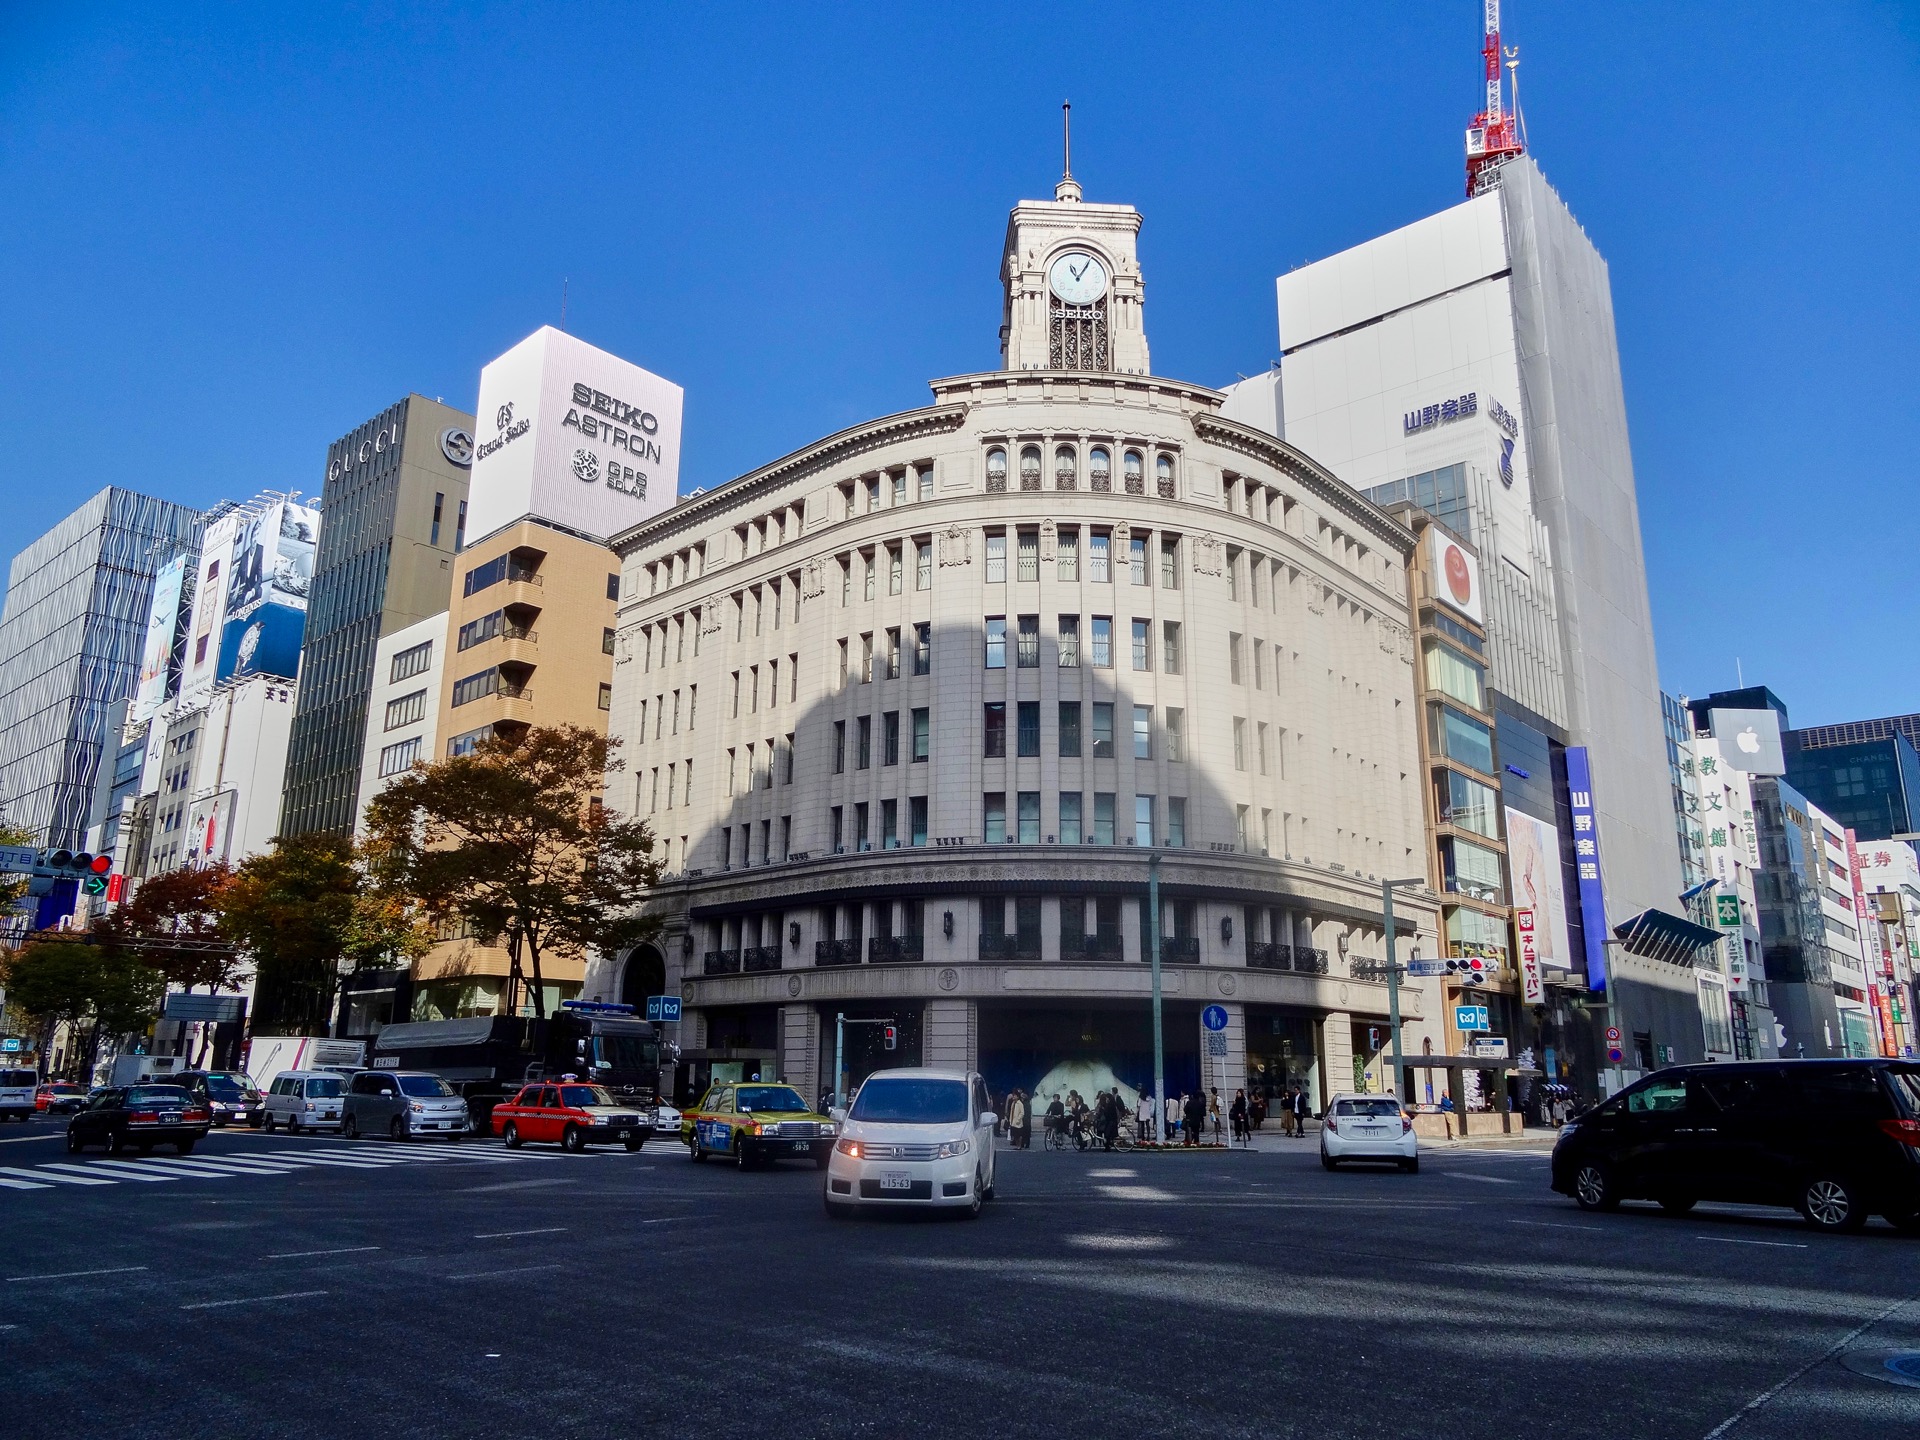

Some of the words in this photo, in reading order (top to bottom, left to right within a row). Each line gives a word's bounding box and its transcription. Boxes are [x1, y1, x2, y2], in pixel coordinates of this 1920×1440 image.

[1055, 308, 1102, 320] SEIKO
[496, 401, 514, 432] GS
[572, 382, 659, 436] SEIKO
[1403, 391, 1478, 432] 山野楽器
[329, 423, 397, 481] GUCCI
[477, 431, 505, 461] Grand
[505, 418, 531, 445] Seiko
[561, 408, 661, 465] ASTRON
[605, 476, 647, 502] SOLAR
[607, 460, 648, 488] GPS
[1850, 753, 1892, 765] CHANEL
[1699, 755, 1727, 849] 教文館
[1572, 791, 1598, 879] 山野楽器
[1718, 899, 1737, 921] 本
[1522, 934, 1539, 999] キムラヤのパン
[888, 1179, 909, 1188] 15-63
